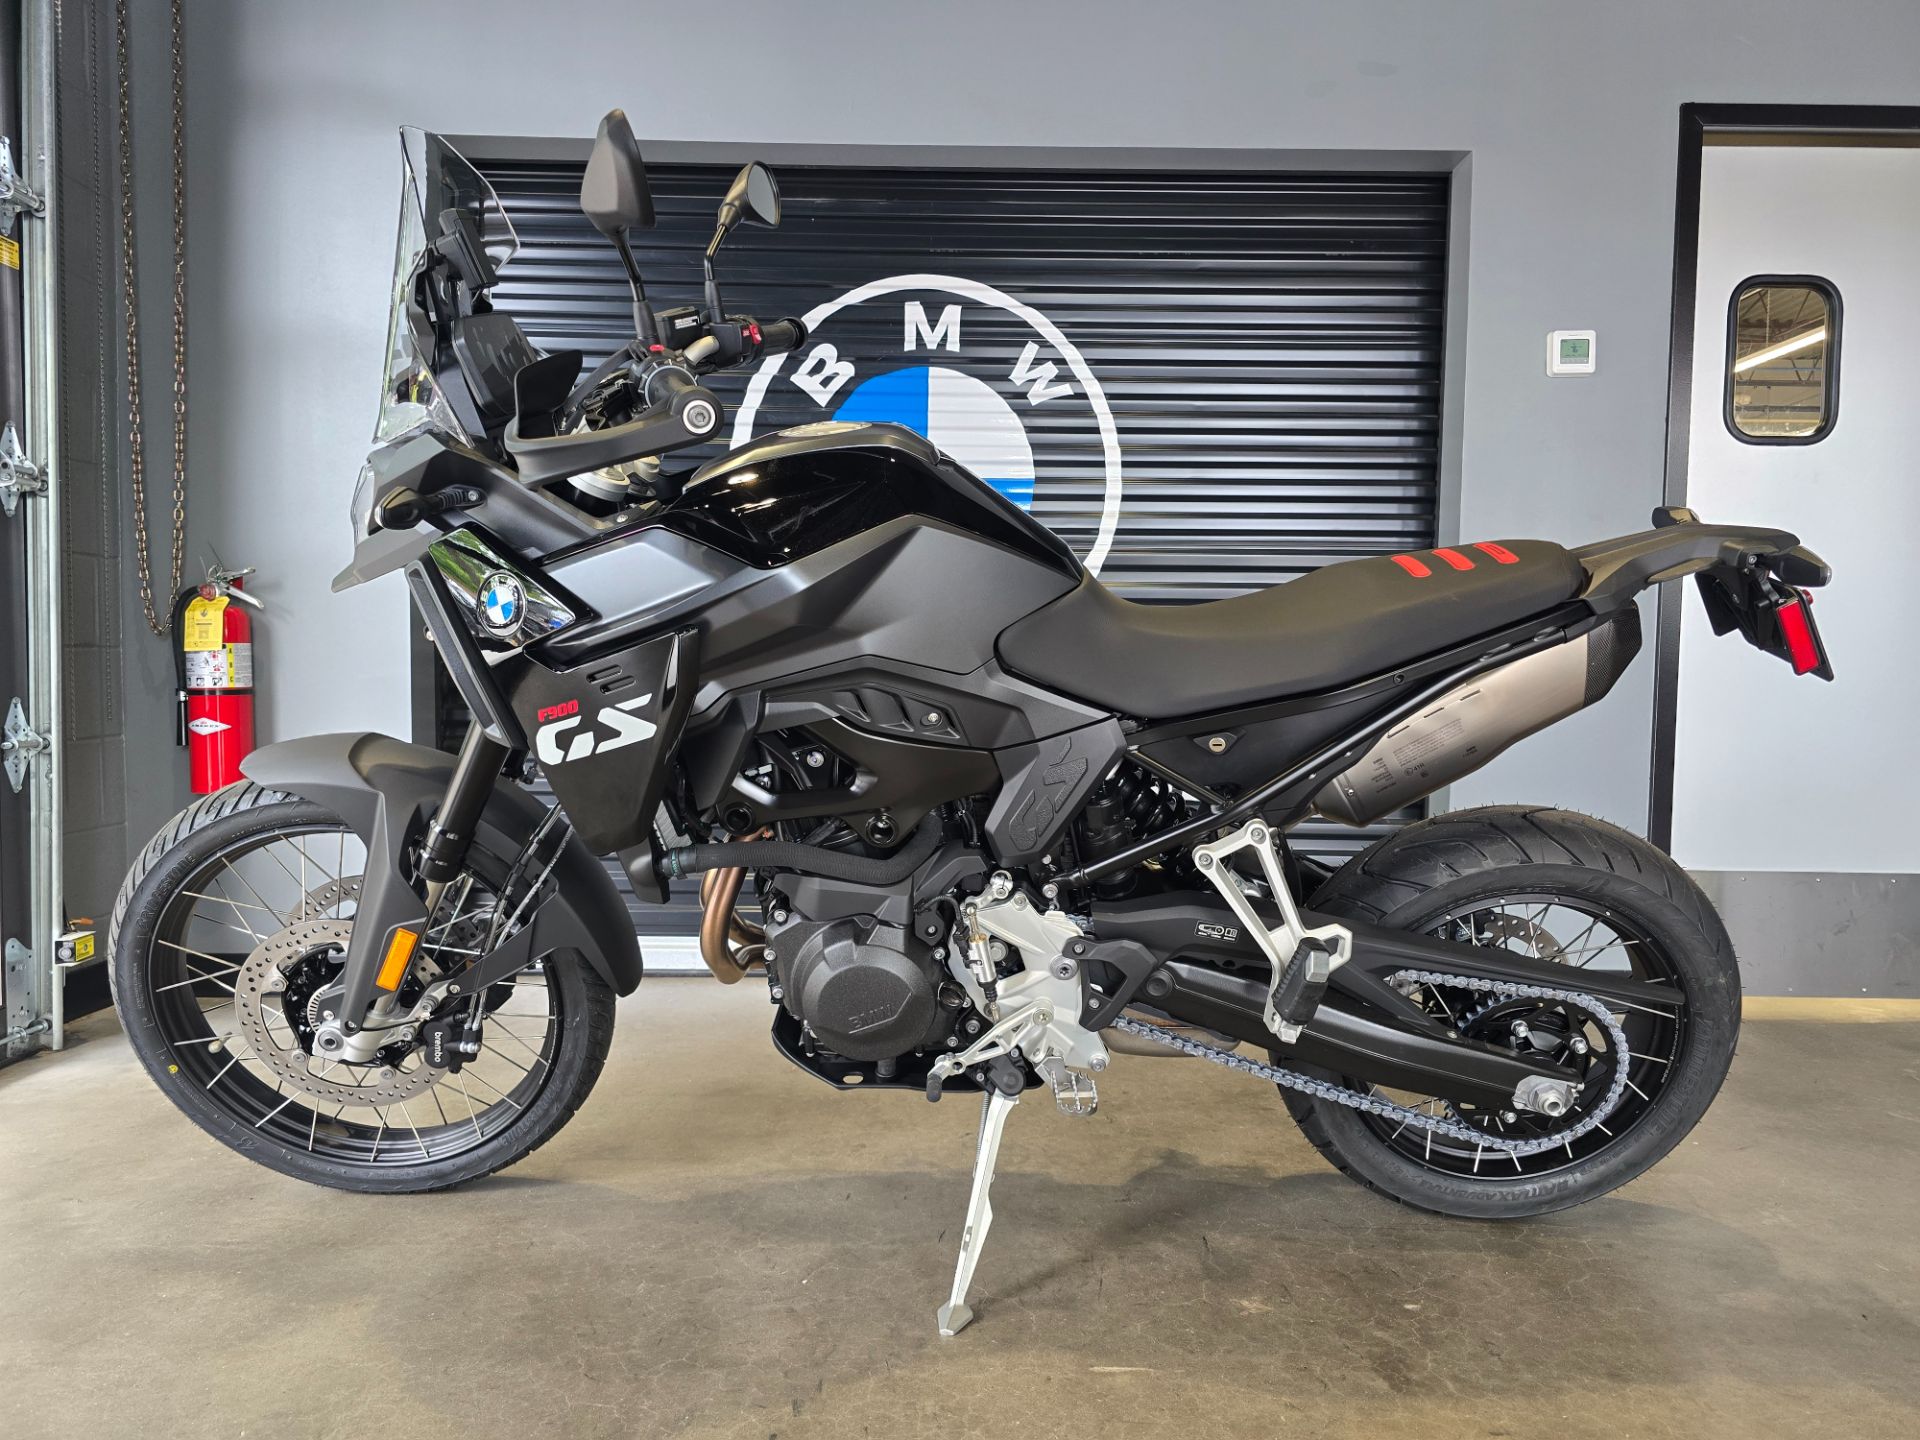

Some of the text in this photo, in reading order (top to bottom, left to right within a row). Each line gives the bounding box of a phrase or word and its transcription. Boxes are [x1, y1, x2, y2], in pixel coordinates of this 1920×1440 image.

[537, 699, 579, 722] F900
[536, 693, 658, 765] GS
[434, 1031, 443, 1063] brembo
